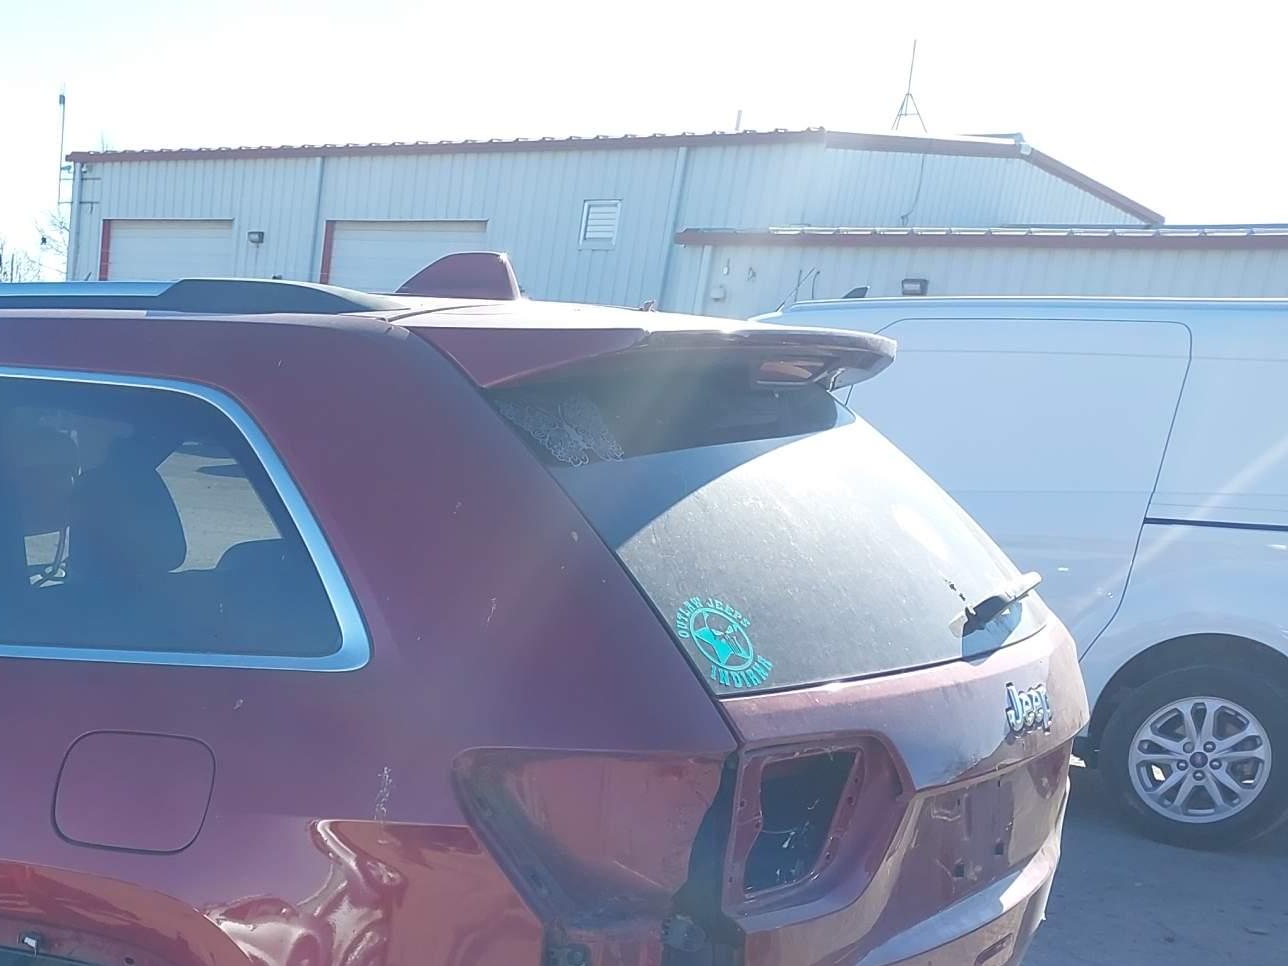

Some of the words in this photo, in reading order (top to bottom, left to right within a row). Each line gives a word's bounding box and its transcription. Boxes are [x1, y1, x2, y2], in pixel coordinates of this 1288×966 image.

[677, 597, 703, 638] OUTLAW
[705, 598, 751, 629] JEEPS
[711, 655, 773, 688] INDIANA
[1005, 682, 1053, 732] Jeep
